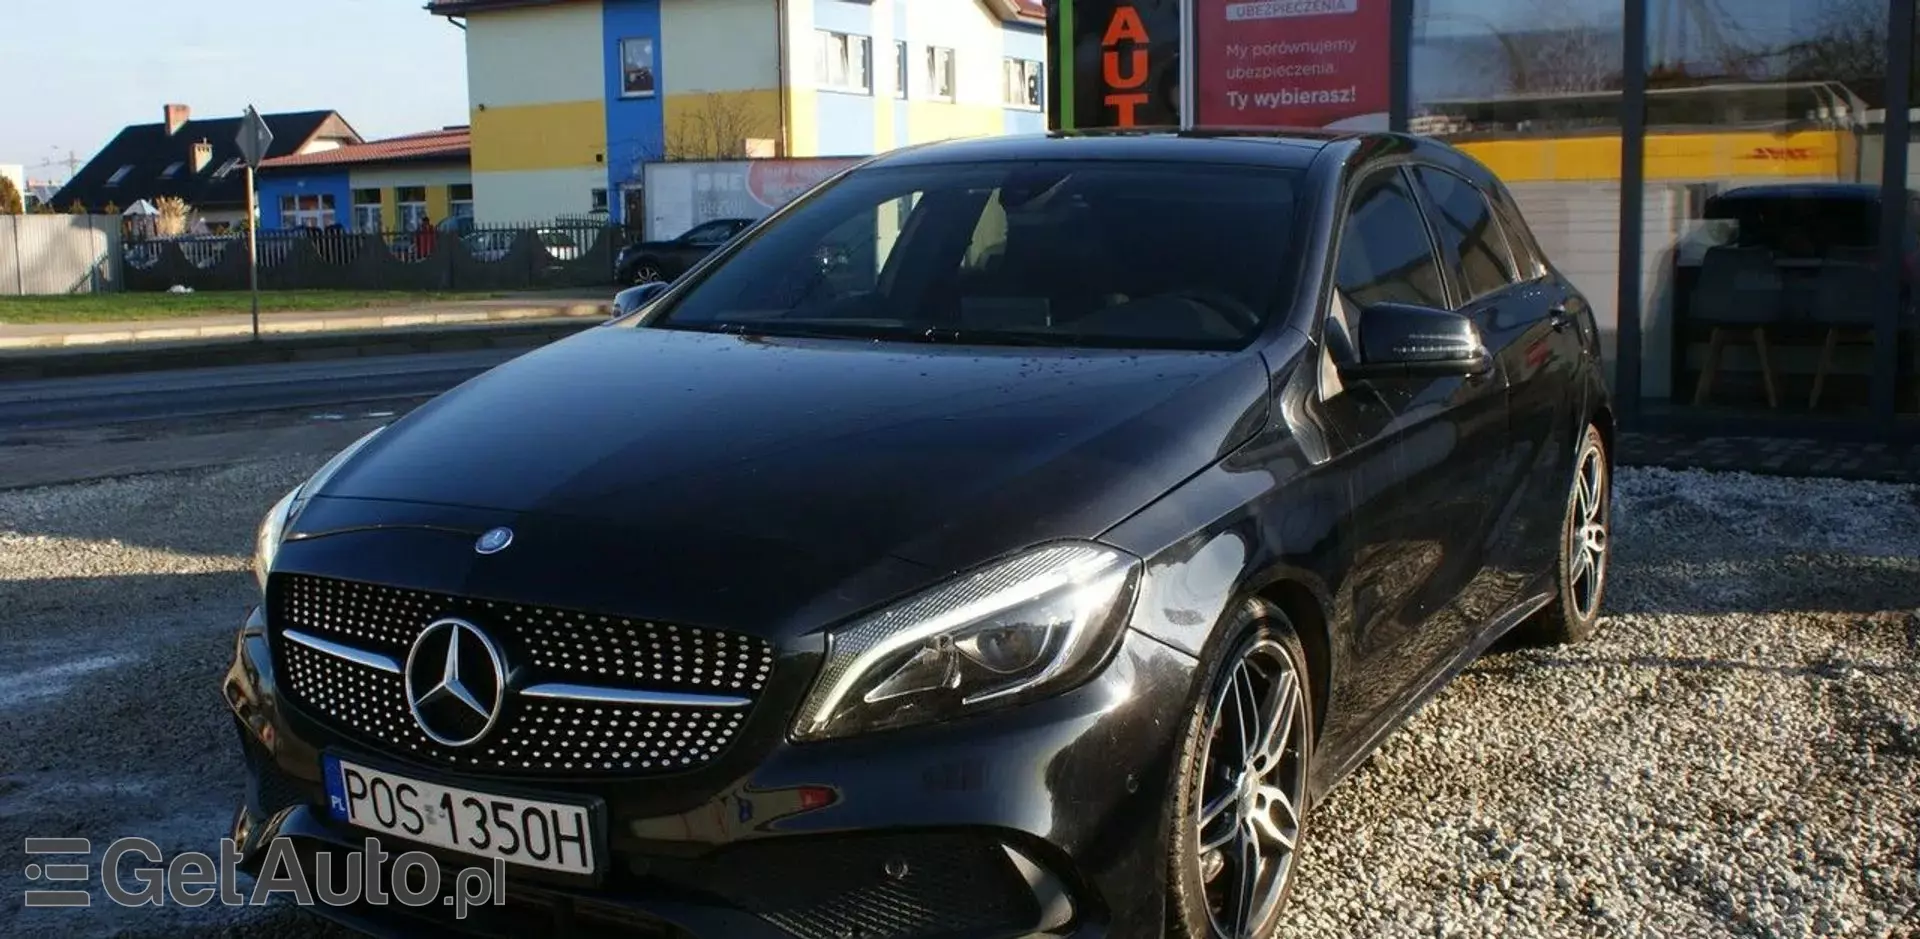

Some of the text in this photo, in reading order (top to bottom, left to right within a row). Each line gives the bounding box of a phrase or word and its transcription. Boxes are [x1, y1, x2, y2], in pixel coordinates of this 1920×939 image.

[1236, 0, 1346, 17] UBEZPIECZENIA
[1226, 39, 1357, 59] My porównujemy
[1226, 85, 1356, 110] Ty wybierasz!
[331, 795, 346, 812] PL
[343, 768, 588, 868] POS 1350H
